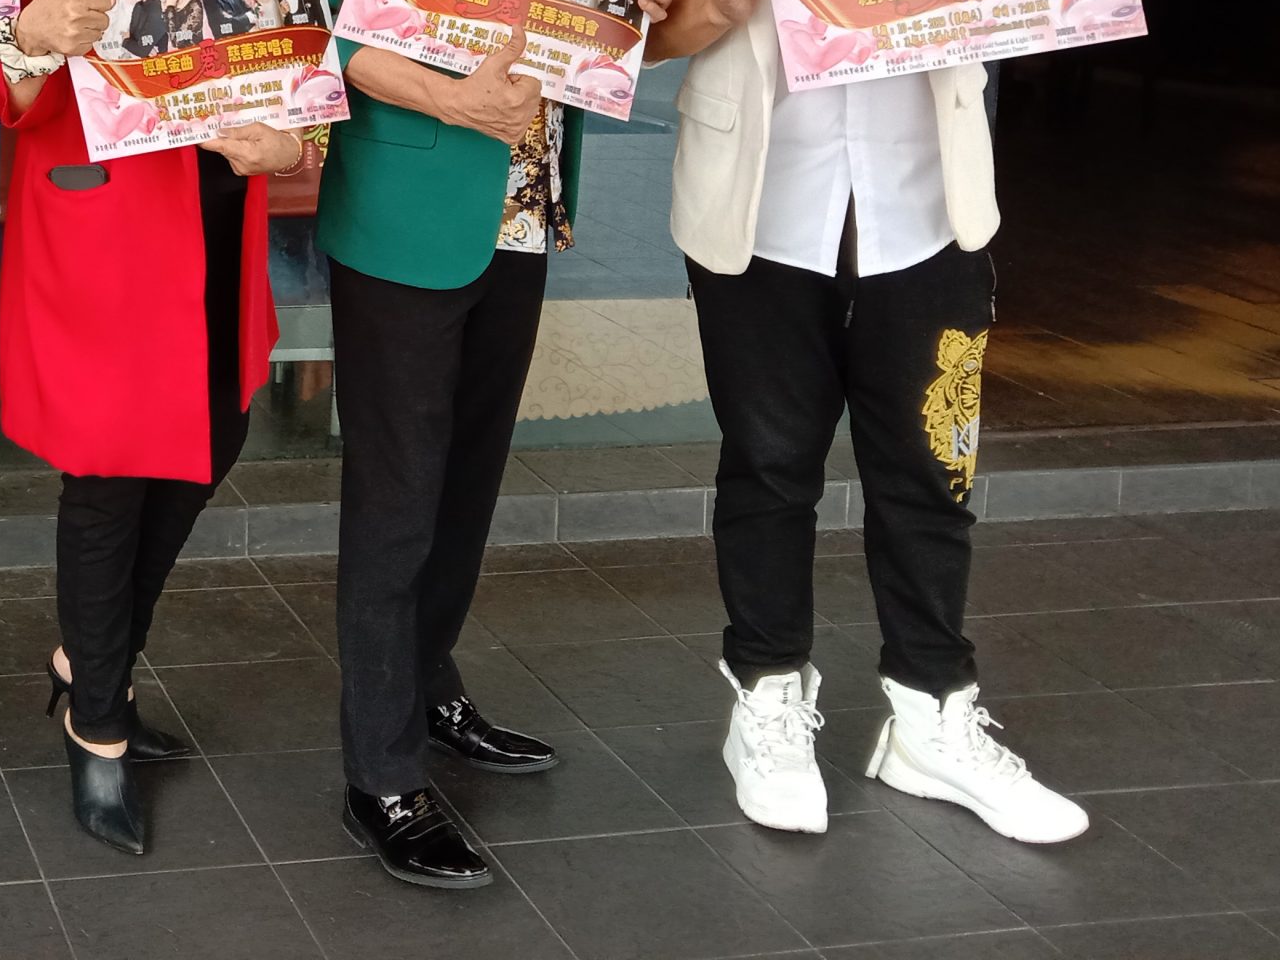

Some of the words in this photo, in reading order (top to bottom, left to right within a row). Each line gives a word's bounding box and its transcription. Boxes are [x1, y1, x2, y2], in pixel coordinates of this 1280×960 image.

[528, 1, 600, 37] 慈善演唱會
[142, 54, 194, 77] 經典金曲
[226, 38, 294, 62] 慈善演唱會
